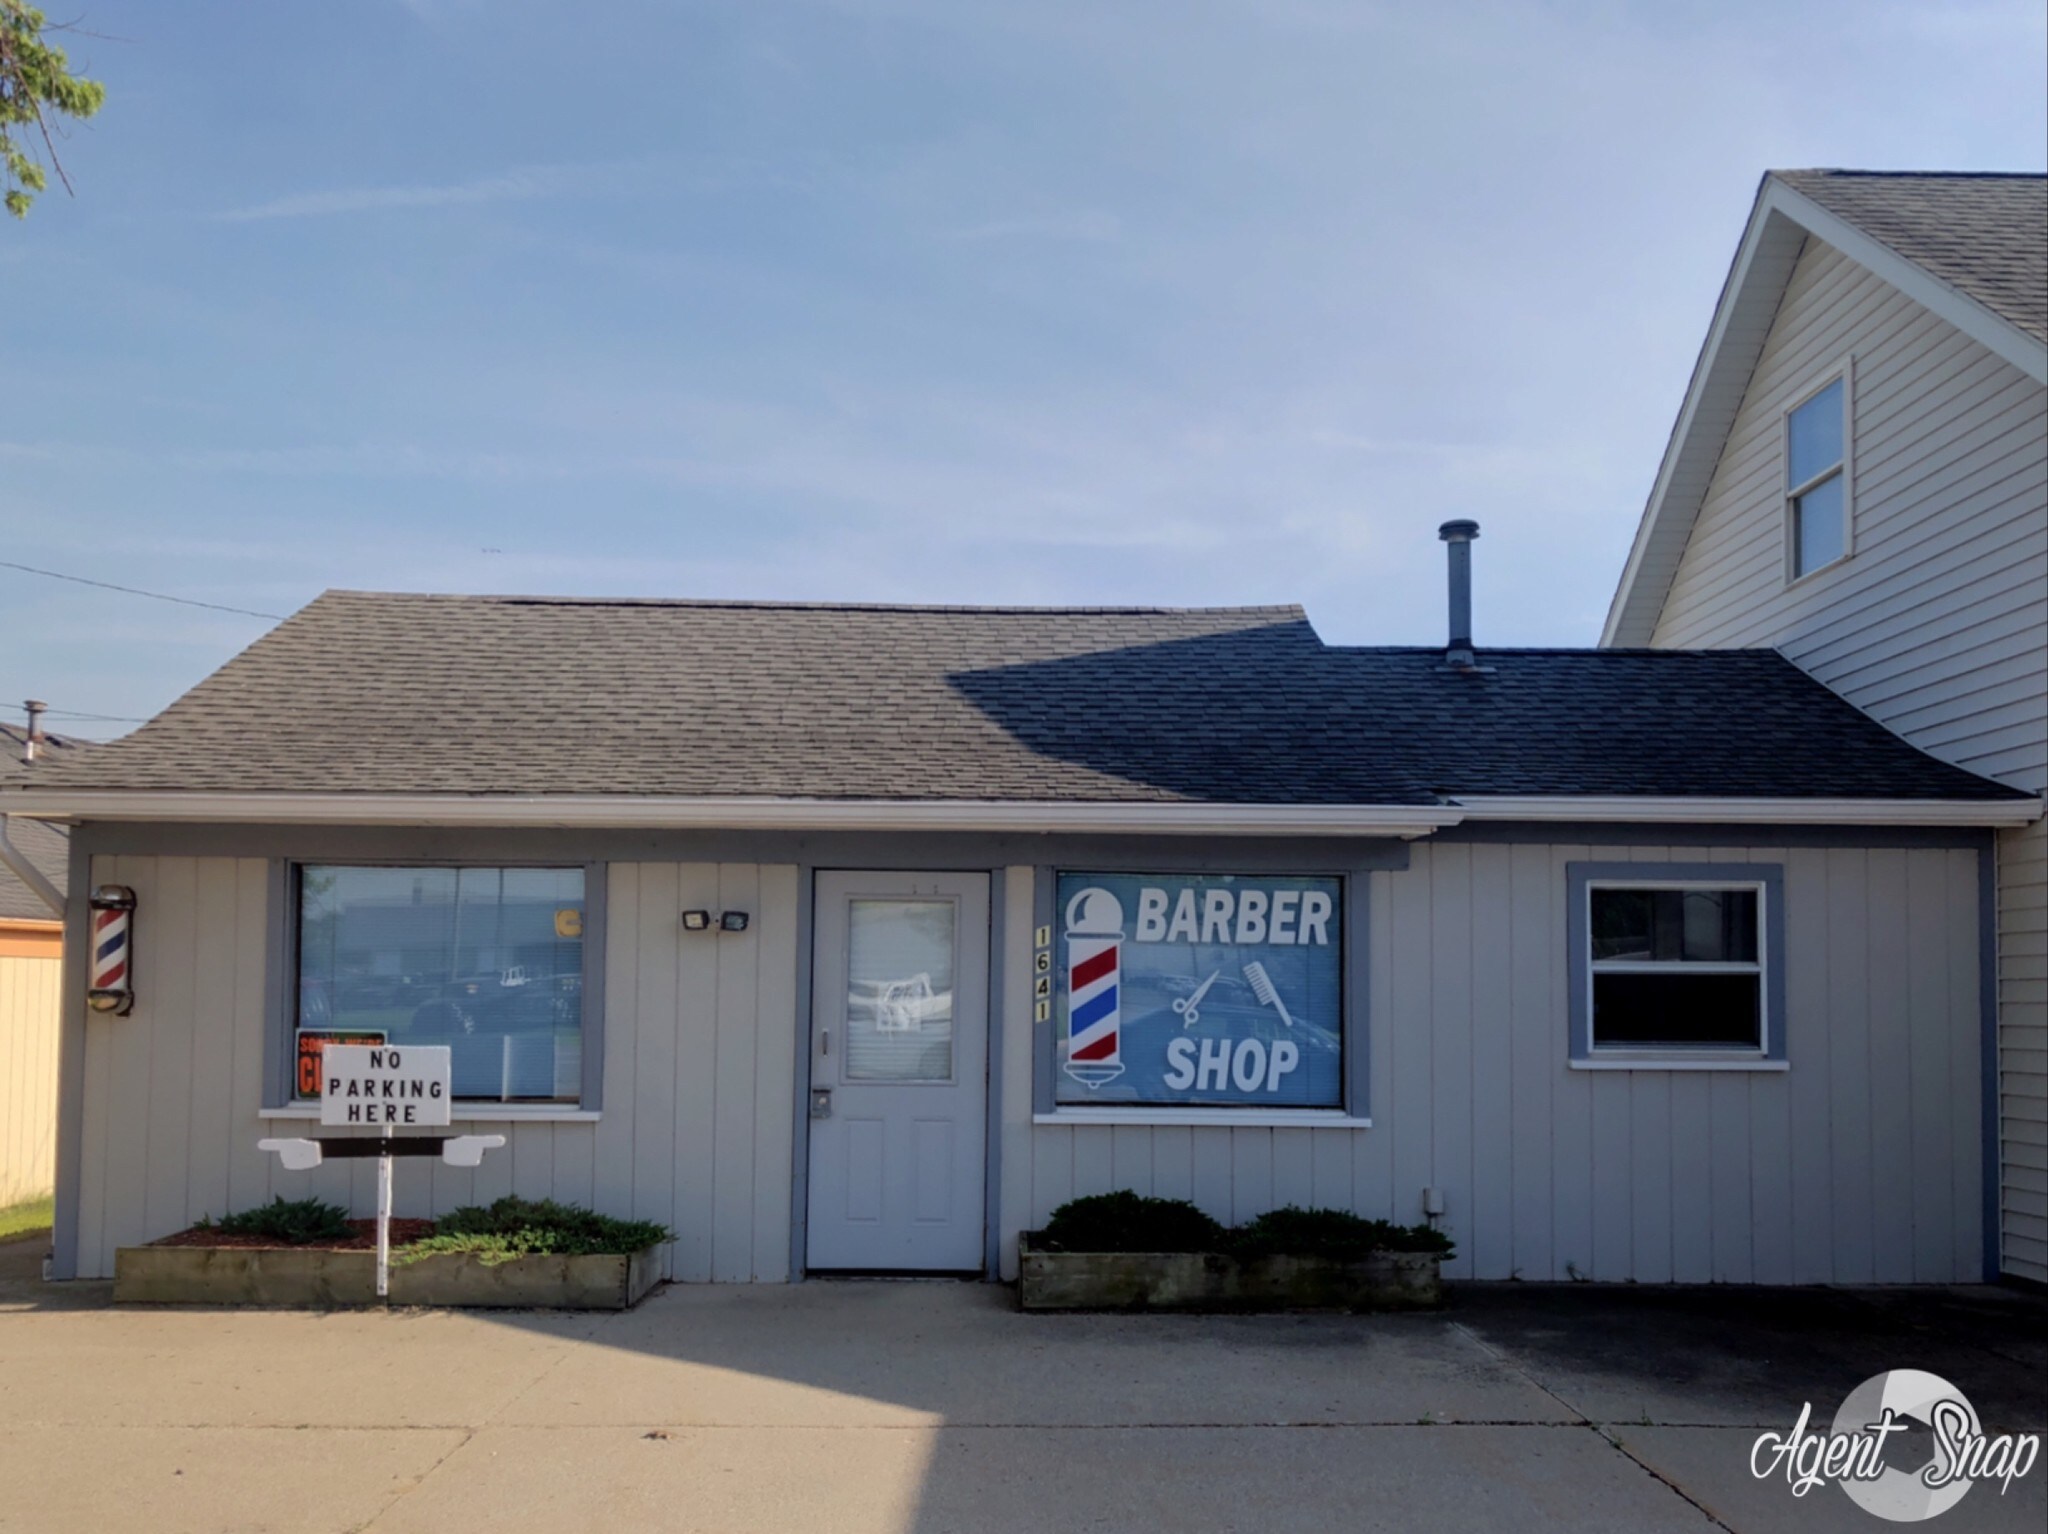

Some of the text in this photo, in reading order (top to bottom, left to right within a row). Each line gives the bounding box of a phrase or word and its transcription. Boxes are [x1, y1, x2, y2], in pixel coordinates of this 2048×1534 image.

[1135, 888, 1332, 945] BARBER
[1037, 927, 1049, 1020] 1641
[370, 1051, 401, 1069] NO
[1163, 1037, 1299, 1092] SHOP
[329, 1078, 442, 1098] PARKING
[348, 1104, 417, 1123] HERE
